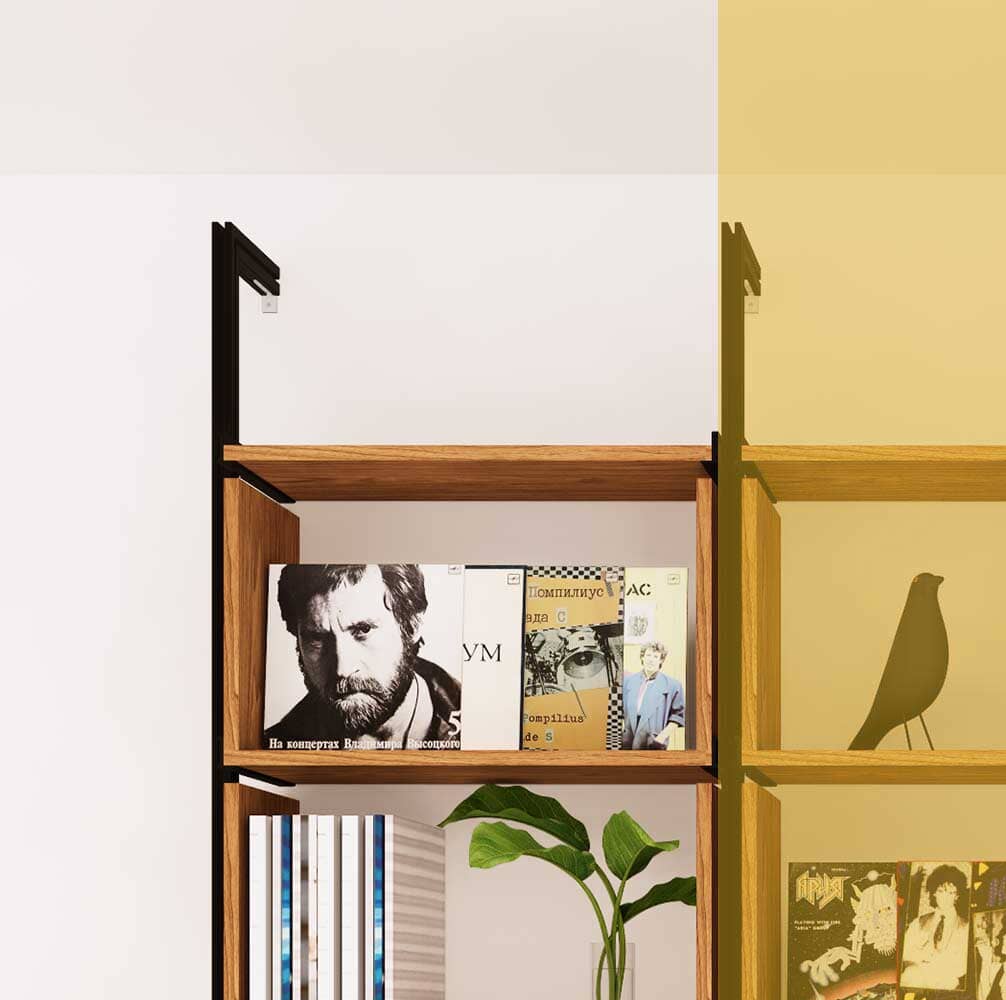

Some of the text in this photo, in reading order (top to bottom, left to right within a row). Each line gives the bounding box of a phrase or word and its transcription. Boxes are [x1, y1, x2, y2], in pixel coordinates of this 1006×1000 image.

[528, 585, 604, 600] Помпилиус
[447, 710, 461, 736] 5
[269, 738, 283, 749] На
[287, 740, 340, 750] концертах
